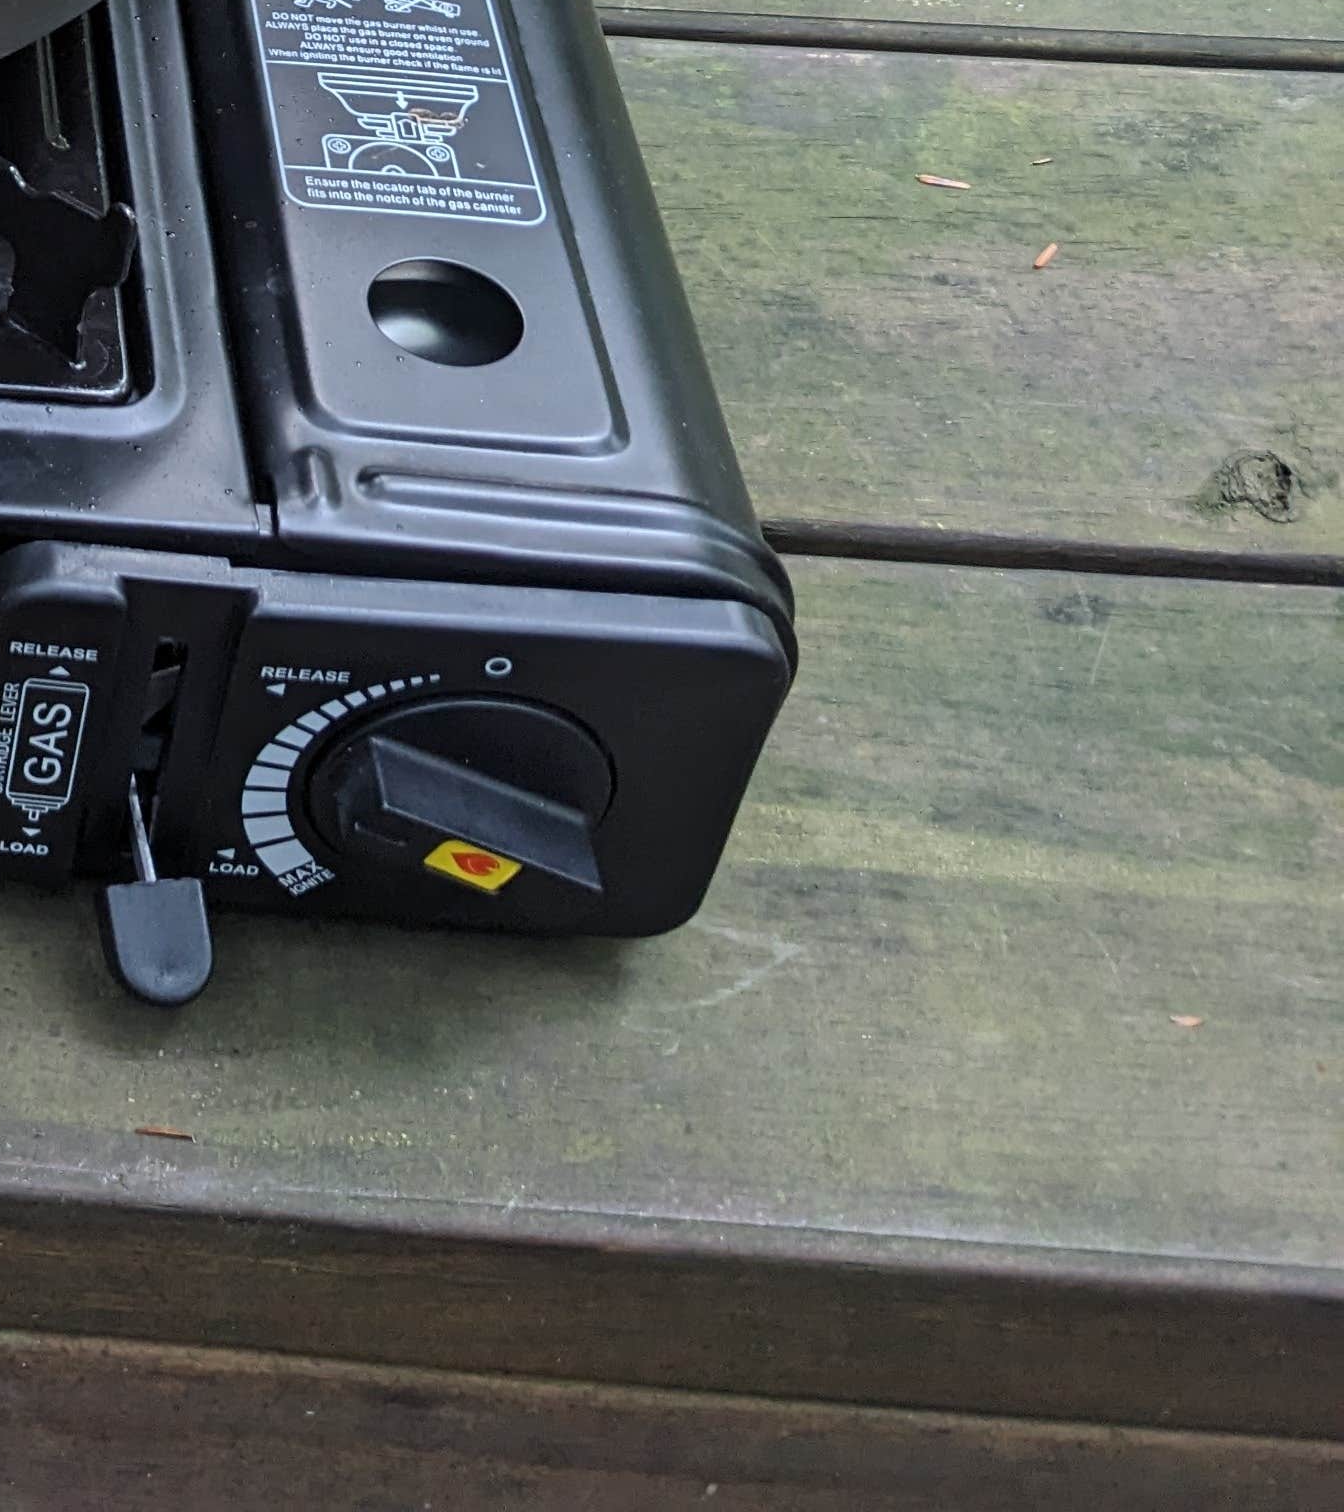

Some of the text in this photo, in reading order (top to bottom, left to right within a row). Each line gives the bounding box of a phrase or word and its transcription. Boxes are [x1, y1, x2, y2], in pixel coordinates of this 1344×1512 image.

[272, 12, 288, 20] DO
[291, 14, 314, 22] NOT
[316, 16, 343, 24] move
[345, 17, 361, 26] the
[363, 20, 382, 28] gas
[383, 21, 416, 30] burner
[265, 21, 308, 31] ALWAYS
[311, 25, 338, 33] place
[340, 26, 356, 35] the
[378, 30, 411, 39] burner
[454, 37, 490, 47] ground
[304, 32, 321, 40] DO
[324, 34, 346, 42] NOT
[389, 40, 422, 49] closed
[268, 48, 298, 57] When
[300, 50, 337, 62] igniting
[339, 52, 356, 62] the
[357, 55, 390, 64] burner
[392, 58, 422, 68] check
[424, 60, 432, 68] if
[433, 62, 449, 70] the
[451, 62, 479, 73] flame
[300, 41, 344, 52] ALWAYS
[346, 46, 381, 54] ensure
[383, 49, 408, 57] good
[305, 176, 514, 202] Ensure the locator tab of the burner
[308, 189, 522, 215] fits into the notch of the gas canister
[10, 641, 98, 662] RELEASE
[261, 666, 350, 684] RELEASE
[0, 682, 20, 721] LEVER
[24, 703, 72, 784] GAS
[0, 840, 48, 855] LOAD
[208, 862, 259, 876] LOAD
[277, 860, 324, 888] MAX
[288, 869, 336, 897] IGNITE
